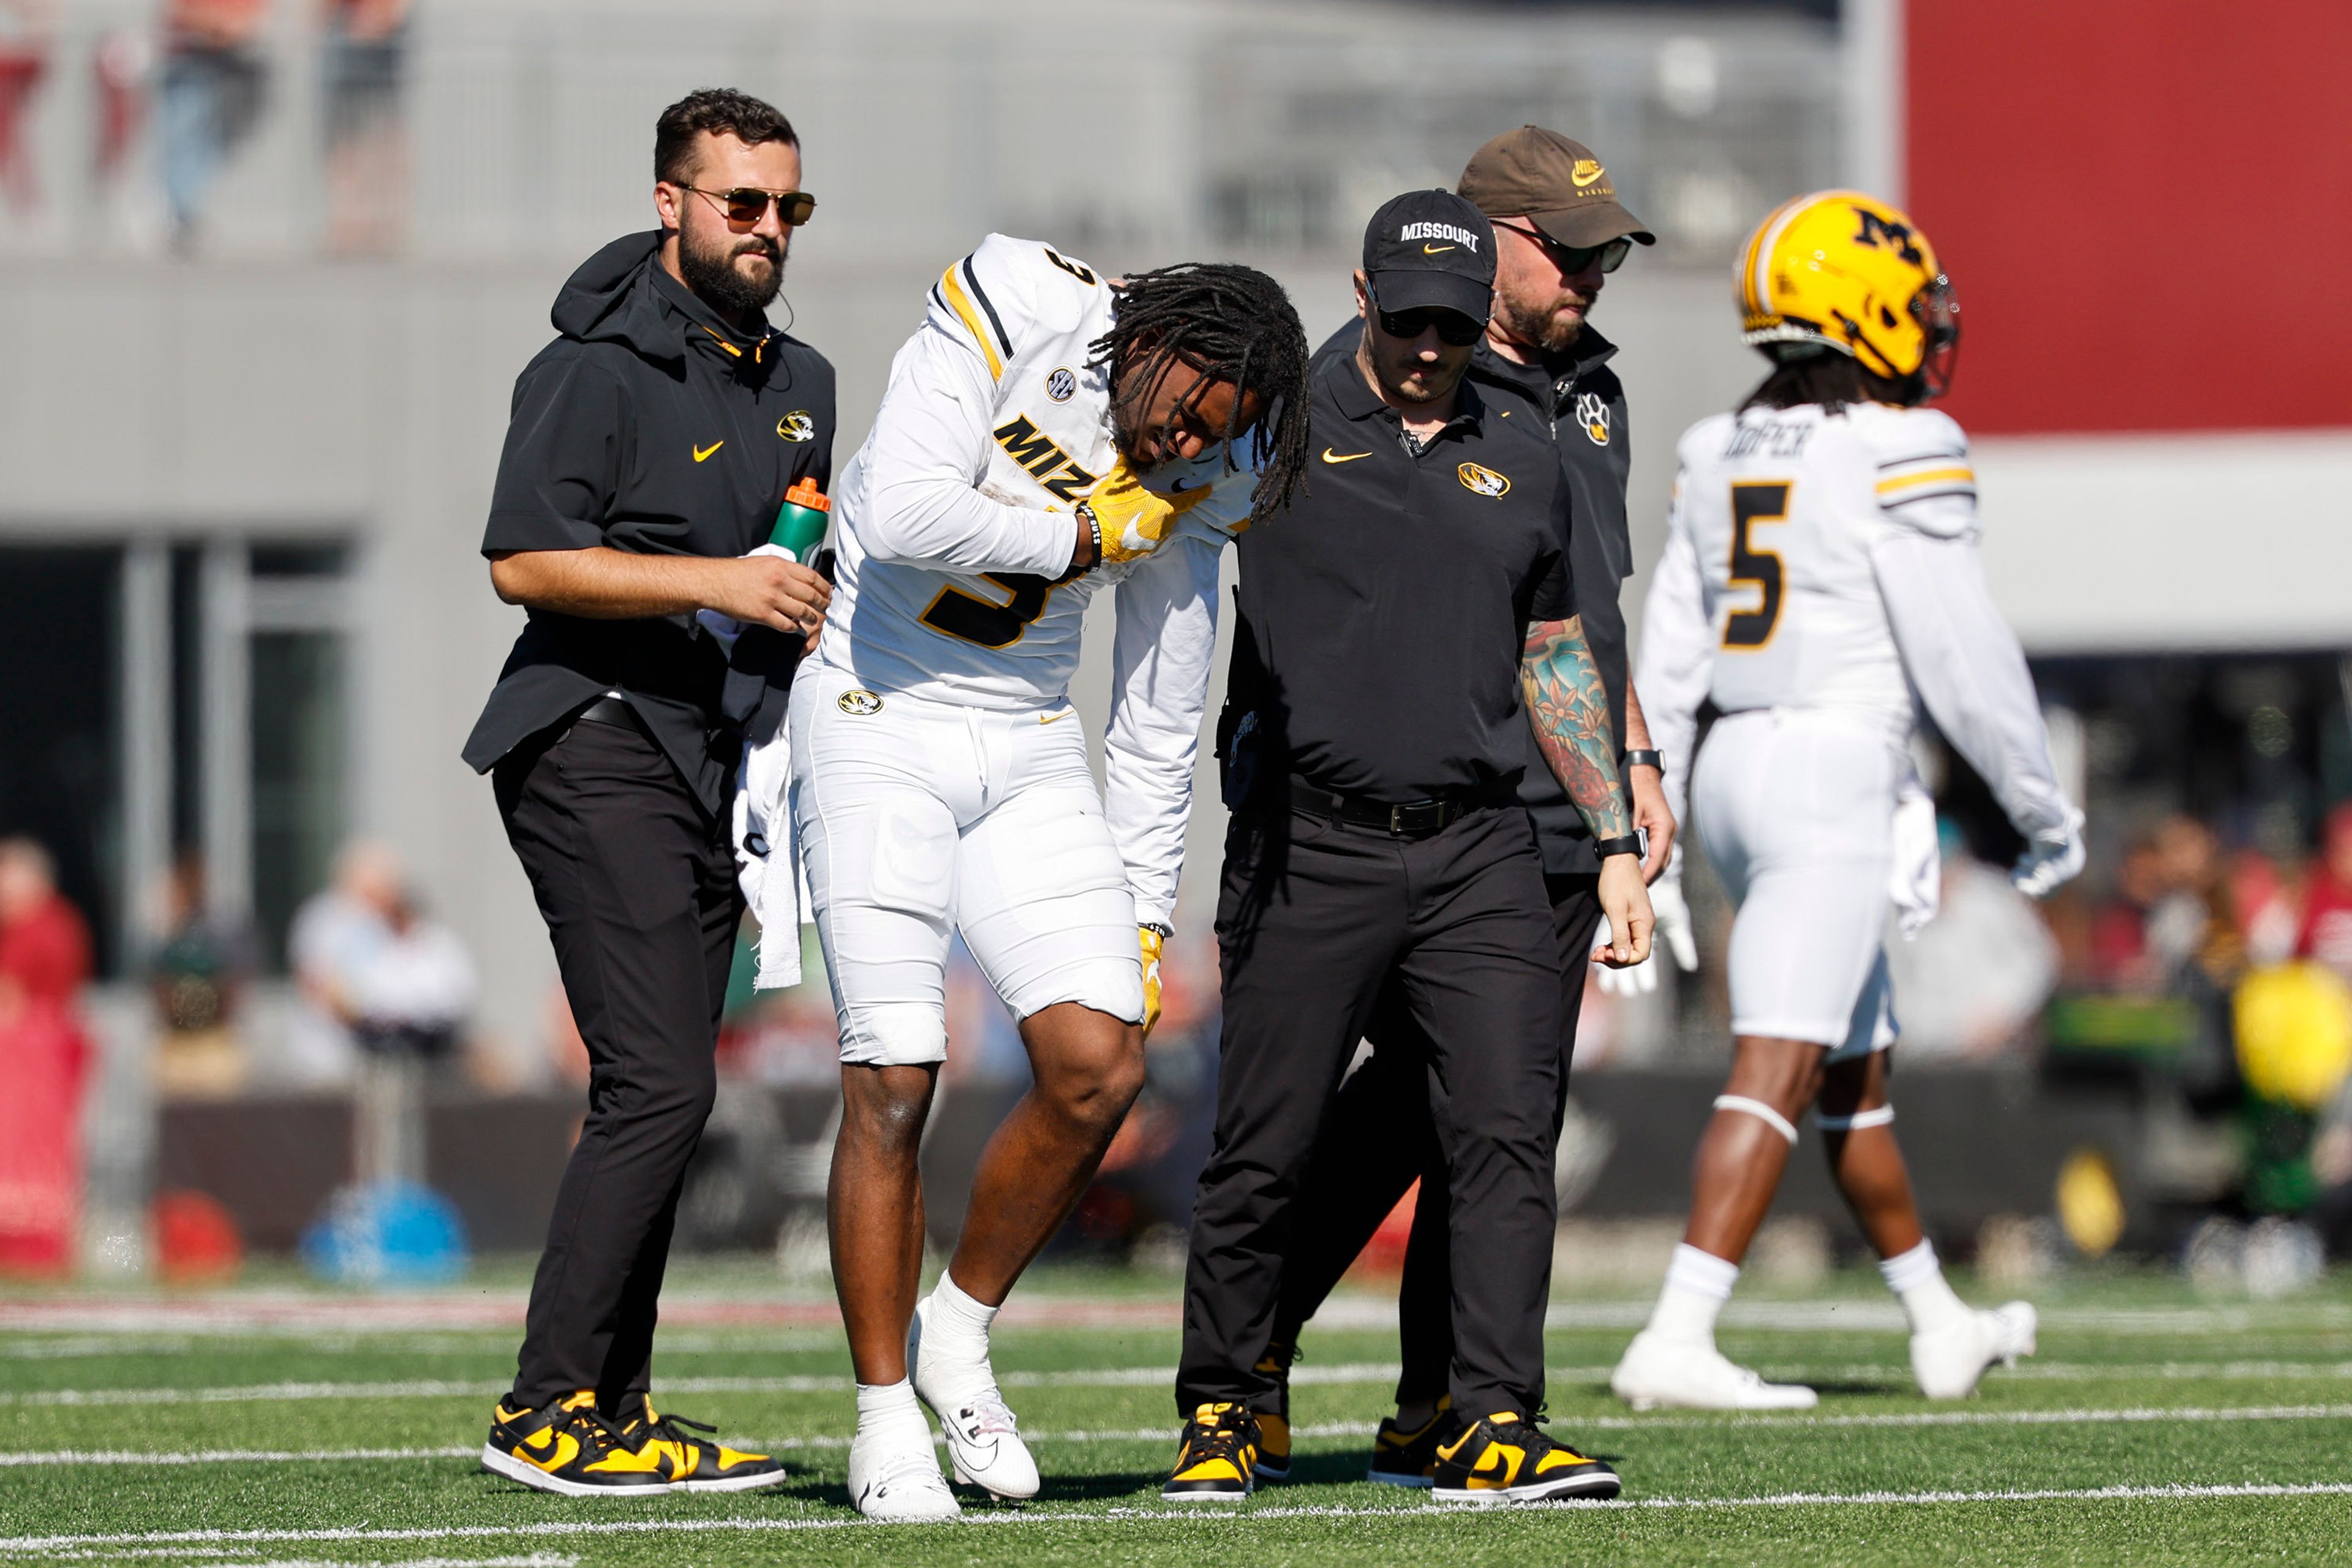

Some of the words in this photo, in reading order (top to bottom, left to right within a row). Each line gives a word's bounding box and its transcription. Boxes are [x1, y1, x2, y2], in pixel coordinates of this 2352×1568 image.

[1400, 222, 1479, 253] MISSOURI
[1852, 208, 1922, 268] M
[1042, 247, 1098, 287] 3
[1048, 370, 1074, 399] SEC
[993, 412, 1098, 509] MIZ
[1721, 480, 1793, 651] 5
